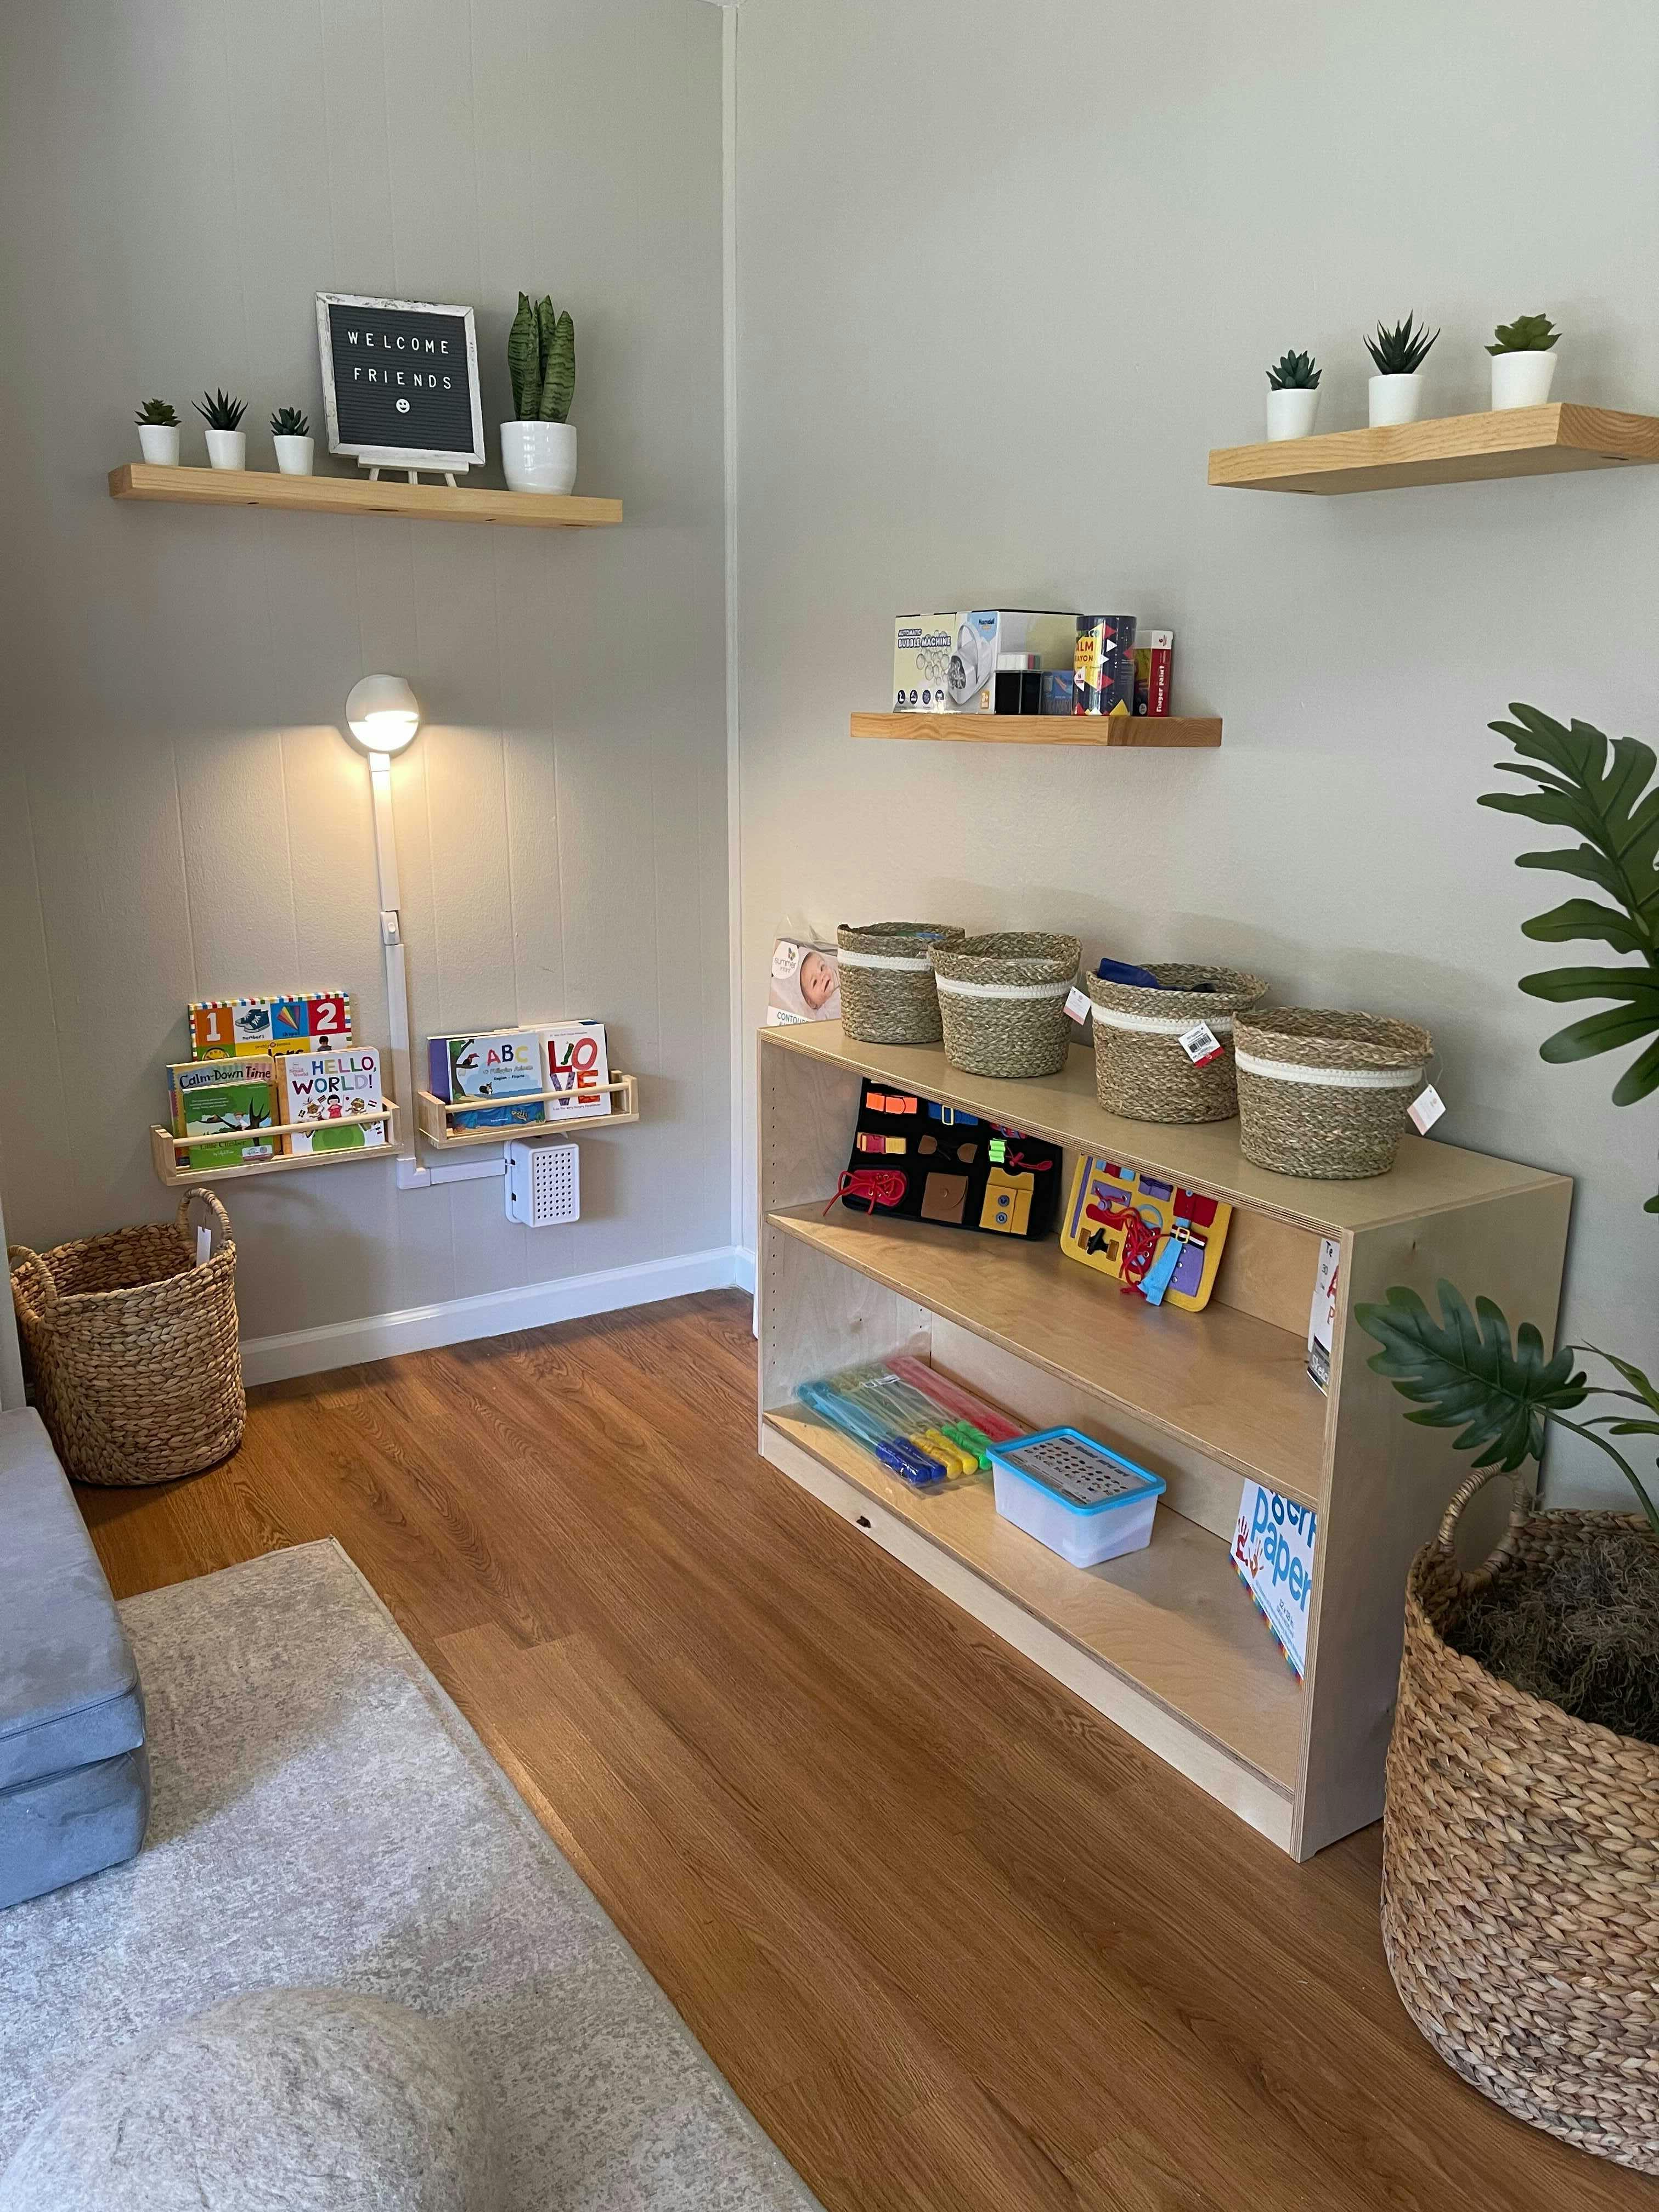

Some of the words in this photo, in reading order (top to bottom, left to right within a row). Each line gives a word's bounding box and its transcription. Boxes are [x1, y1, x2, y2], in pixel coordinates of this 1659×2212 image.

[348, 331, 449, 354] WELCOME
[354, 368, 452, 390] FRIENDS
[898, 629, 922, 637] AUTOMATIC
[898, 638, 921, 648] BUBBLE
[921, 636, 951, 647] MACHINE
[775, 958, 796, 969] summer
[206, 1012, 221, 1041] 1
[317, 1002, 337, 1030] 2
[312, 1056, 377, 1076] HELLO,
[487, 1044, 528, 1066] ABC
[179, 1069, 243, 1088] Calm-Down
[246, 1066, 271, 1079] Time
[292, 1074, 373, 1095] WORLD!
[1250, 1486, 1312, 1612] paper
